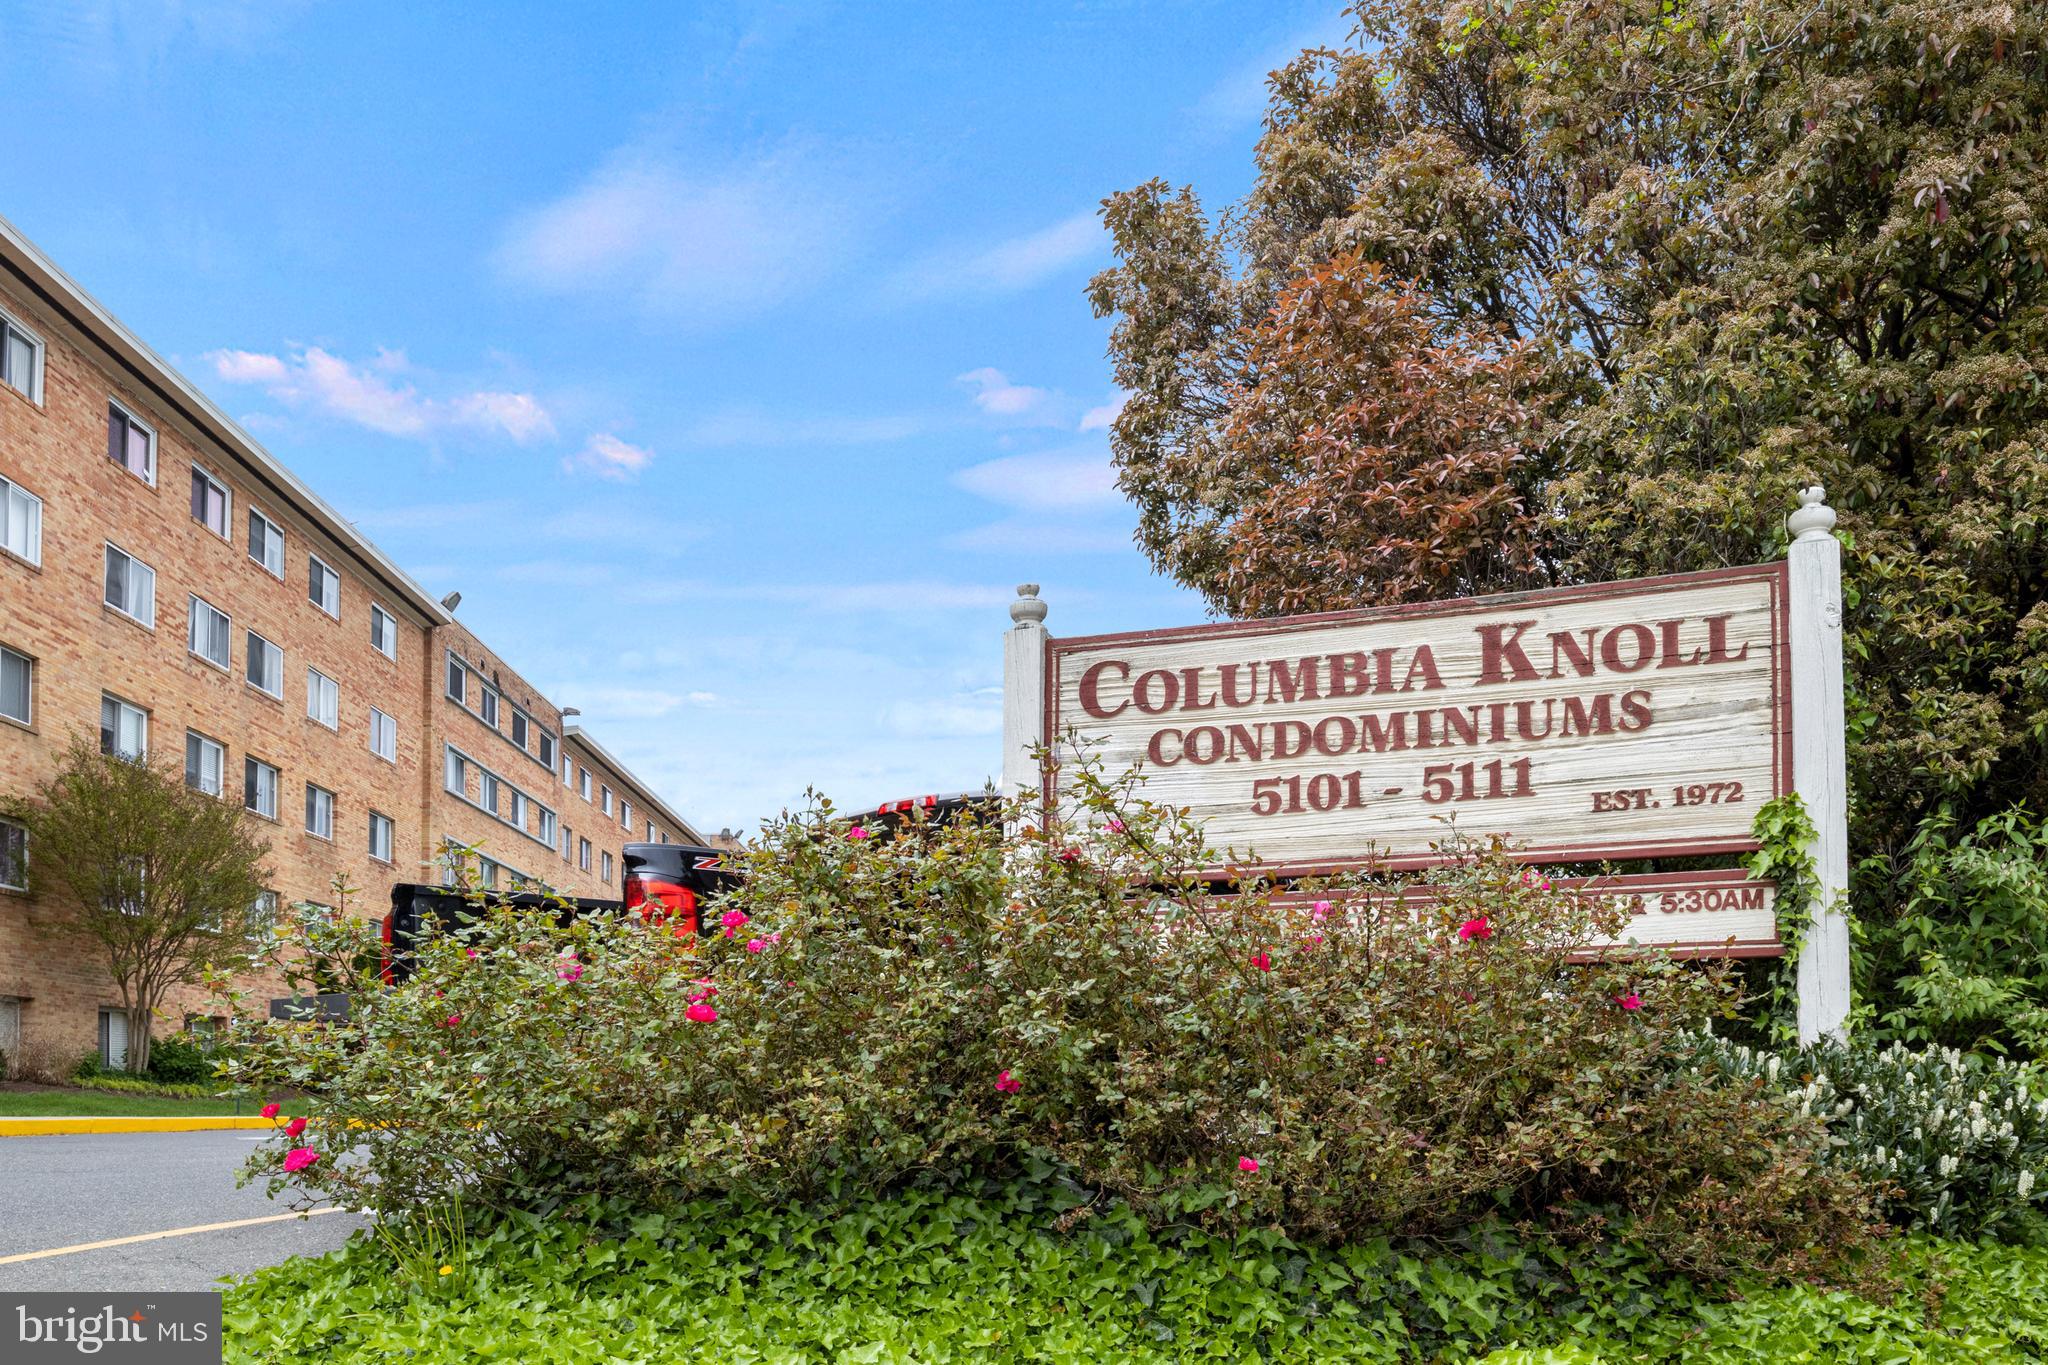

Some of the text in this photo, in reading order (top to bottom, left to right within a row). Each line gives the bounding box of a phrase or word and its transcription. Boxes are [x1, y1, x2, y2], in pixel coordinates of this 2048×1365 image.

[1079, 613, 1748, 719] COLUMBIA KNOLL
[1148, 690, 1652, 767] CONDOMINIUMS
[1250, 770, 1367, 816] 5101
[1422, 757, 1537, 805] 5111
[1590, 782, 1744, 812] EST. 1972
[1660, 888, 1764, 914] 5:30AM
